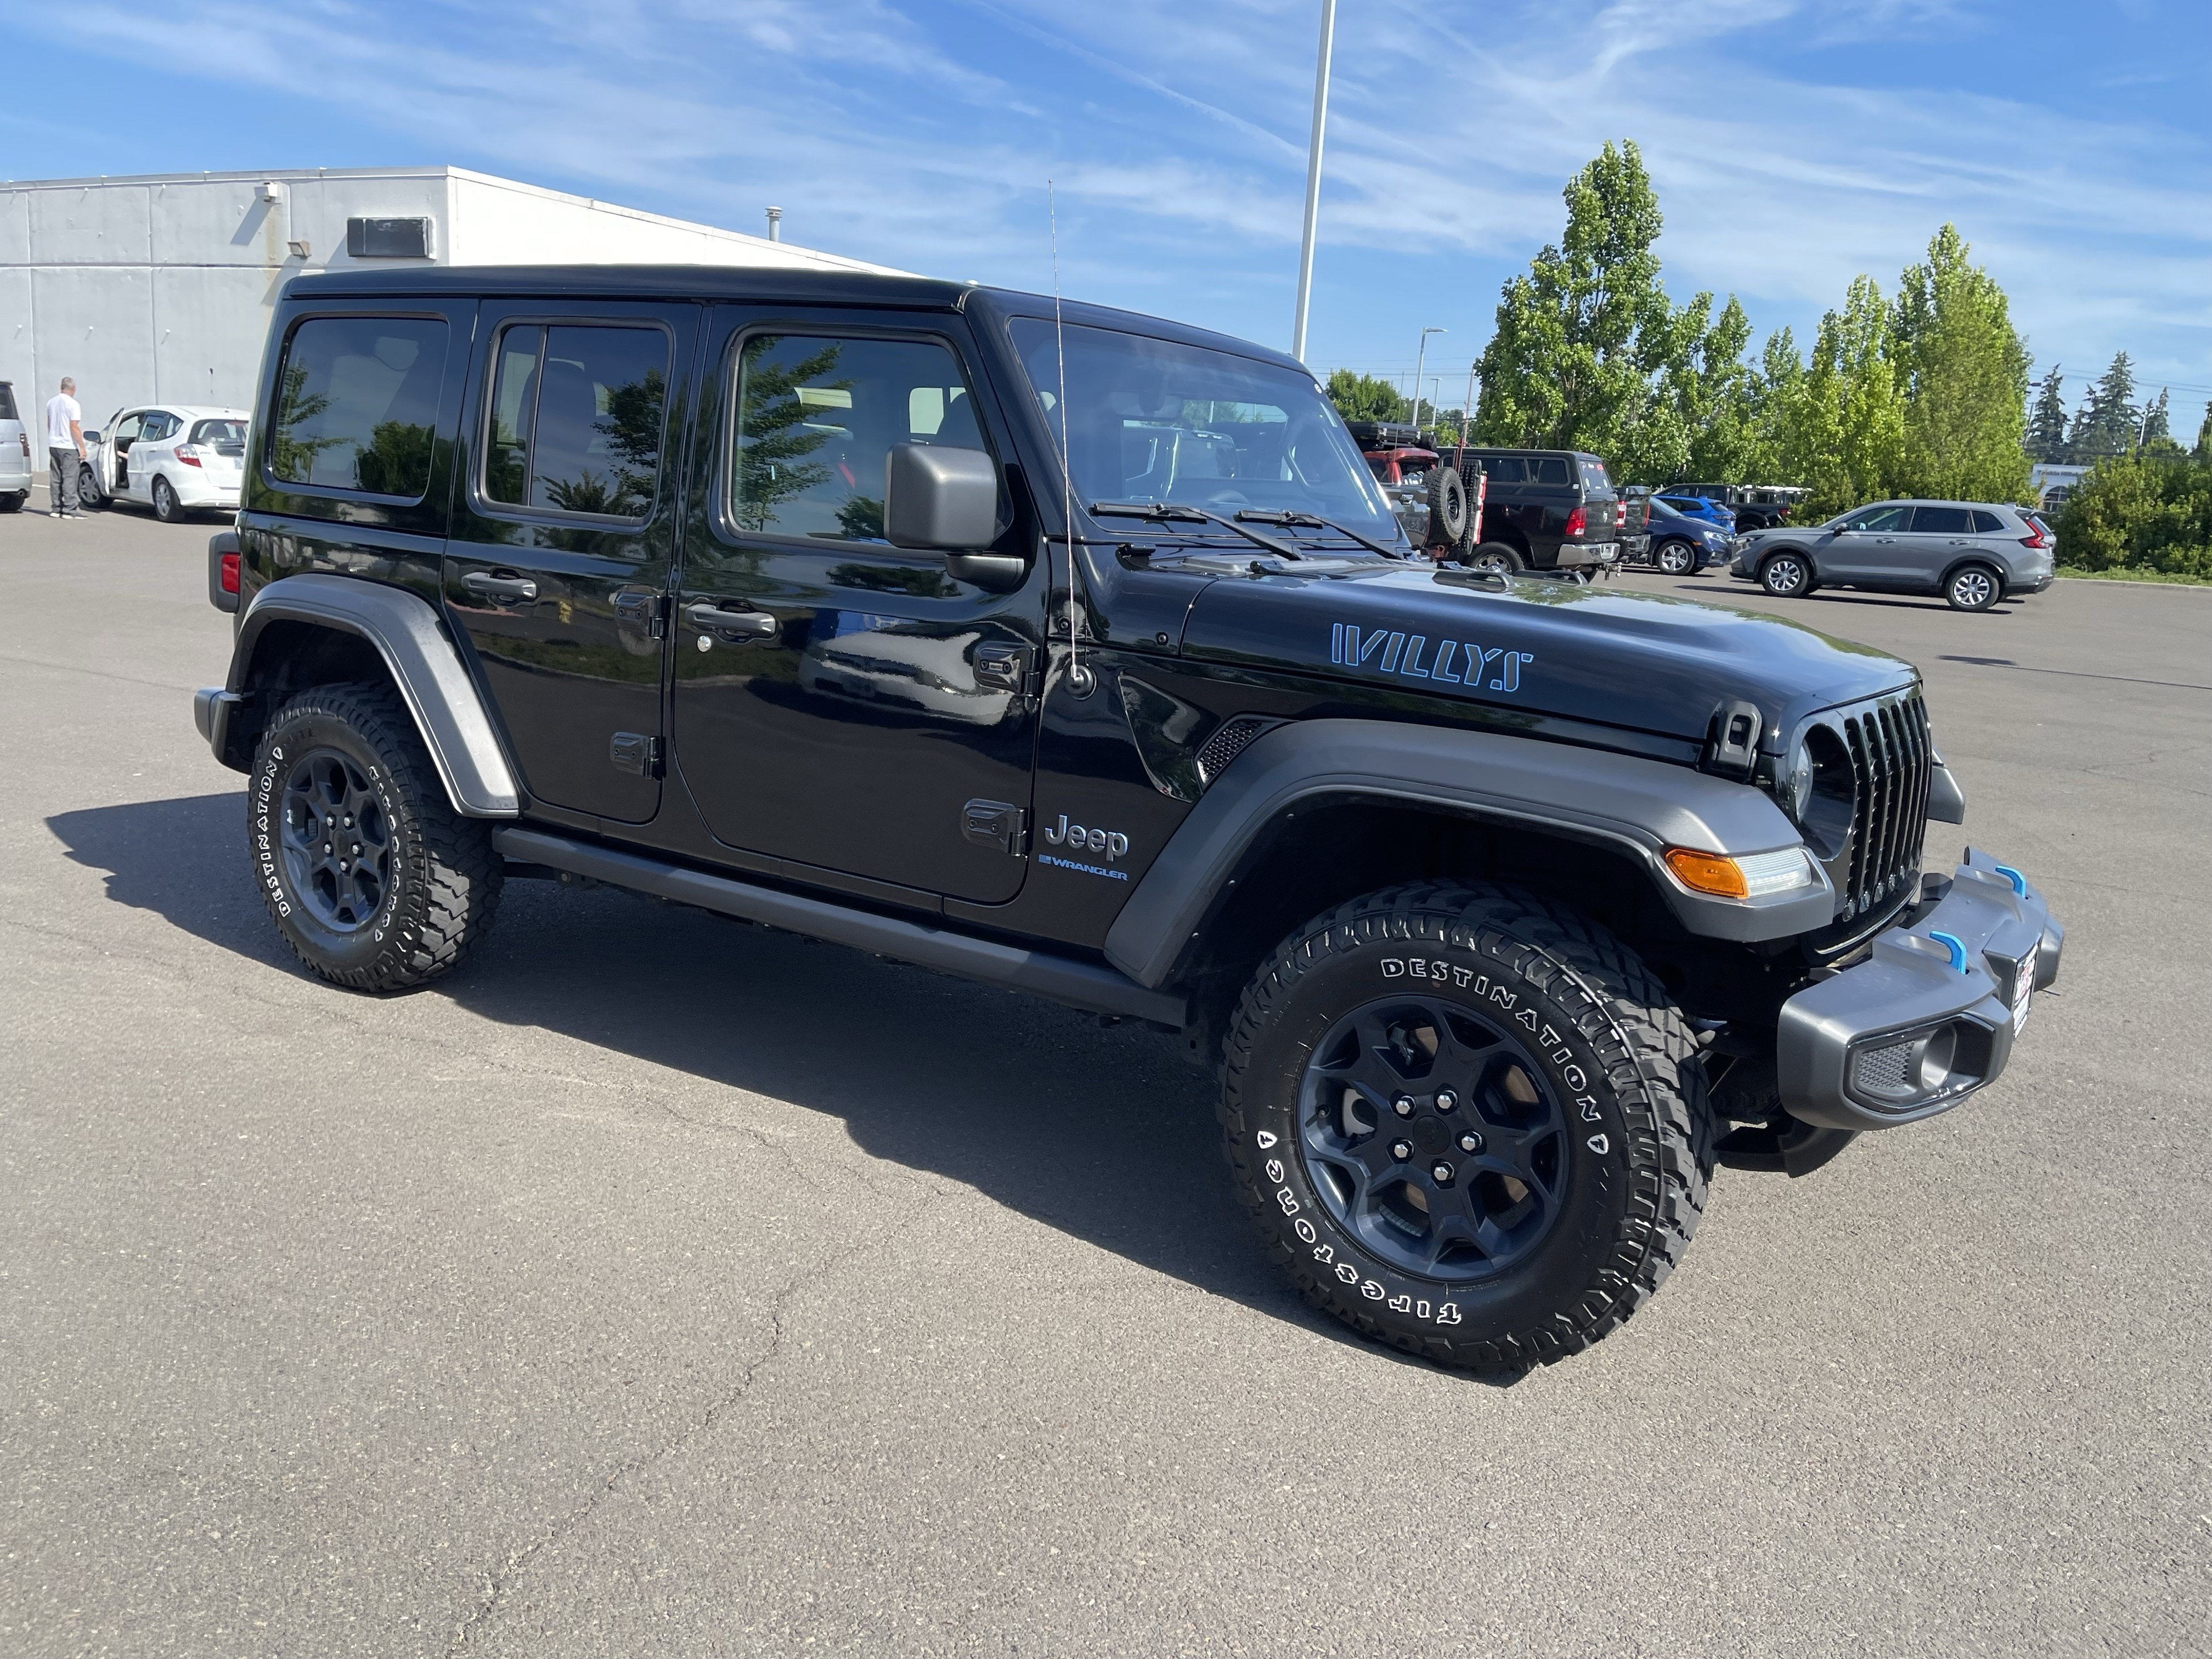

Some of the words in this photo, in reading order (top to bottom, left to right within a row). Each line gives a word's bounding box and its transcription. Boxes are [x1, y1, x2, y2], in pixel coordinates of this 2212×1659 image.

[1331, 623, 1534, 692] WILLYS
[257, 759, 291, 918] DESTINATION
[1045, 814, 1128, 862] Jeep
[1052, 856, 1128, 881] WRANGLER
[1381, 958, 1602, 1123] DESTINATION
